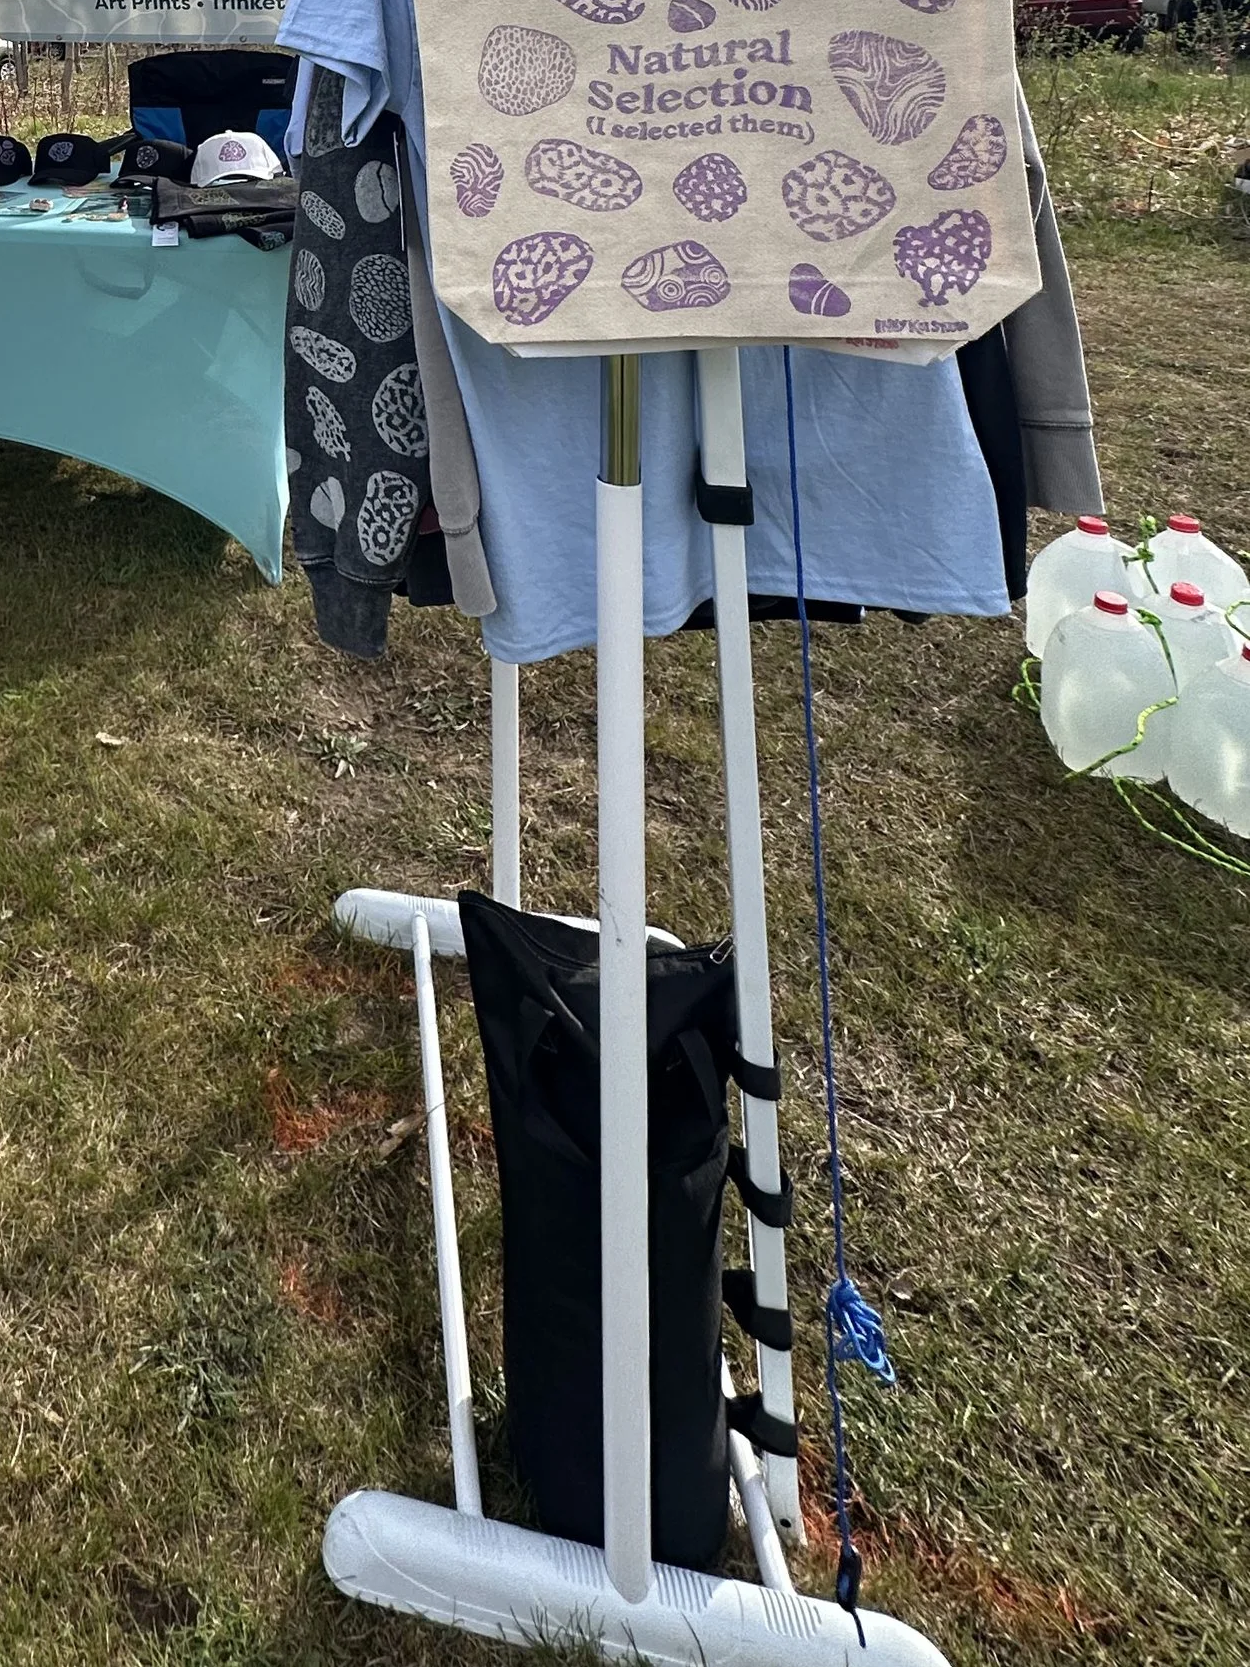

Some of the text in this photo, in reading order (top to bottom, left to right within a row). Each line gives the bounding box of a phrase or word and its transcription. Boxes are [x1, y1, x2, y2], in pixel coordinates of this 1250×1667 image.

[606, 29, 794, 75] Natural
[587, 67, 813, 114] Selection
[585, 112, 816, 145] (I selected them)
